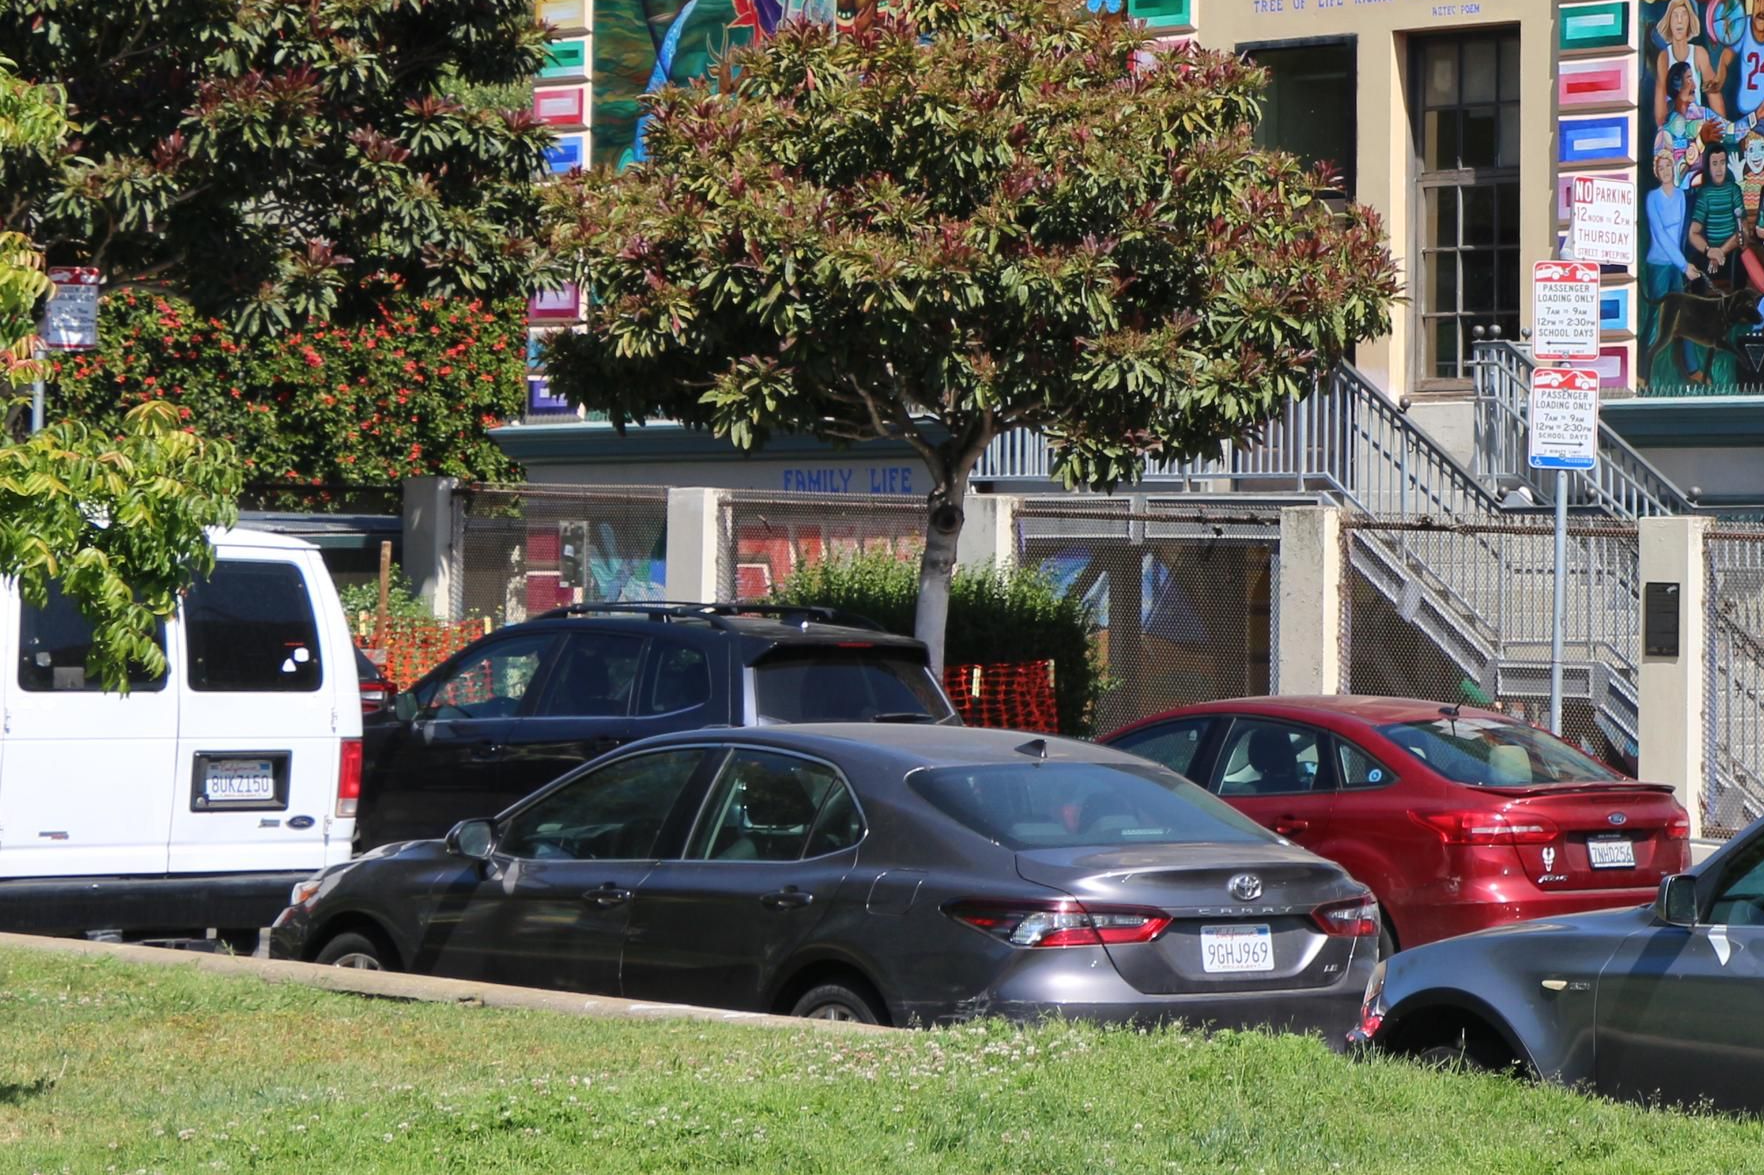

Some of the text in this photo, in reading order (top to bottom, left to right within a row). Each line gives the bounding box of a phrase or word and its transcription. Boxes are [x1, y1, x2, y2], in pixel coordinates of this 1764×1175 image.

[1432, 4, 1480, 16] AZTEC POEM
[1576, 180, 1632, 205] NO PARKING
[1578, 228, 1629, 245] THURSDAY
[1577, 248, 1630, 260] STREET SWEEPING
[1542, 284, 1590, 293] PASSENGER
[1537, 294, 1595, 303] LOADING ONLY
[1545, 307, 1560, 315] 7AM
[1572, 307, 1587, 315] 9AM
[1537, 318, 1556, 326] 12PM
[1567, 318, 1596, 326] 2:30PM
[1538, 328, 1594, 337] SCHOOL DAYS
[1541, 391, 1589, 400] PASSENGER
[1535, 401, 1593, 410] LOADING ONLY
[1544, 413, 1558, 421] 7AM
[1570, 414, 1584, 423] 9AM
[1536, 422, 1554, 431] 12PM
[1563, 423, 1592, 432] 2:30PM
[783, 468, 912, 493] FAMILY LIFE
[211, 775, 269, 793] 8UKZ150
[1591, 847, 1632, 862] 7NHD256
[1199, 906, 1293, 914] CAMRY
[1208, 941, 1268, 965] 9GHJ969
